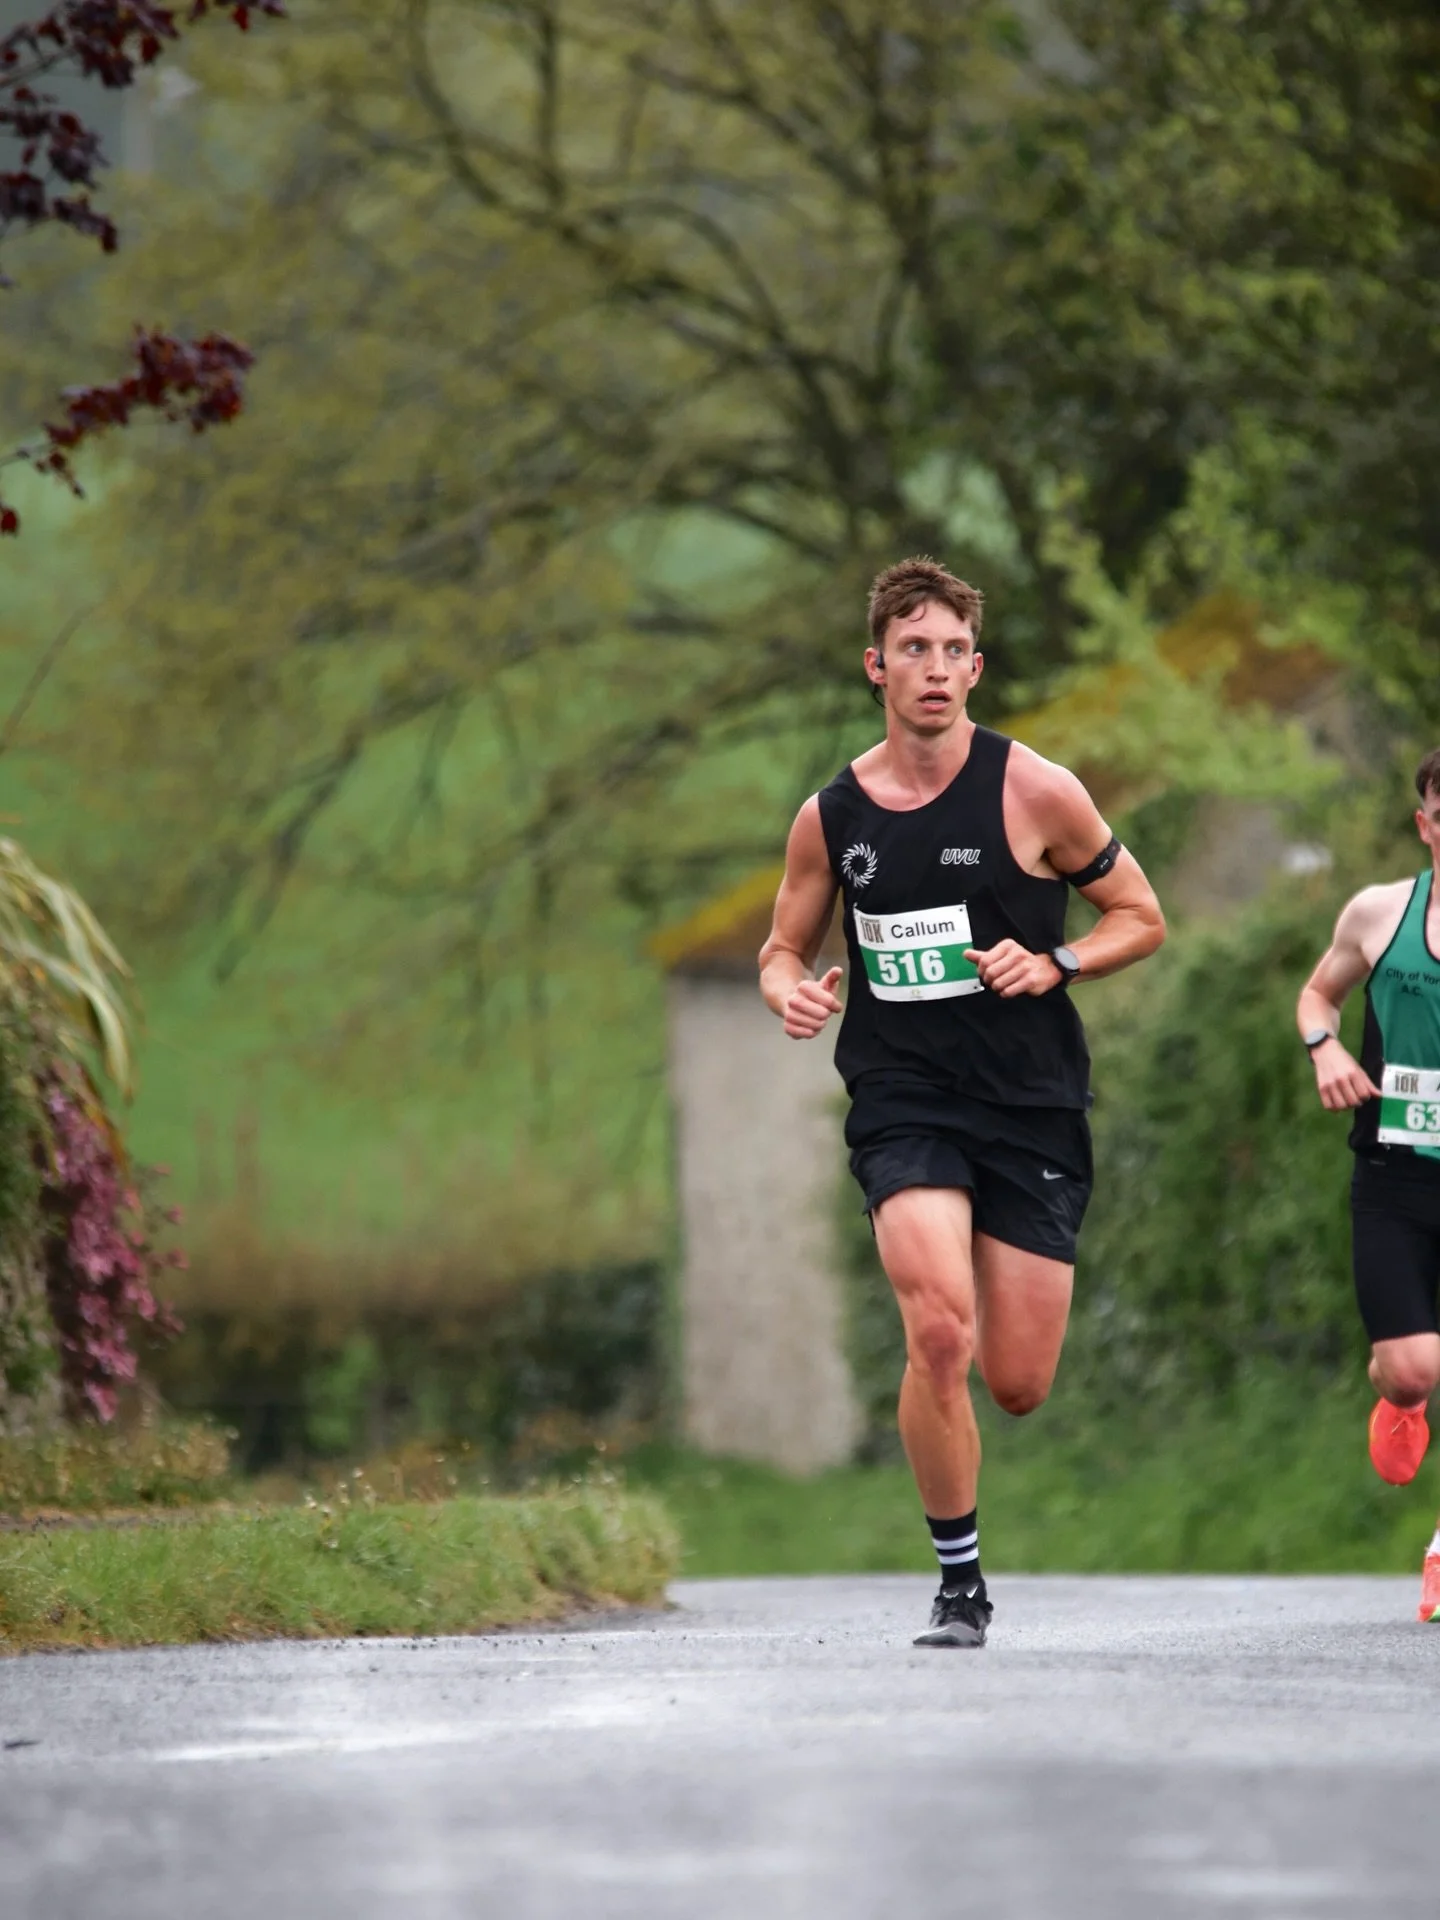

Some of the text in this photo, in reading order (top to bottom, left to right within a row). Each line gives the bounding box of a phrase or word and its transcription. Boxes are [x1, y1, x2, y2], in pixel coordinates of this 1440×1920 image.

[860, 919, 955, 943] 10K Callum
[878, 949, 945, 985] 516
[1386, 967, 1406, 981] City
[1408, 971, 1420, 981] of
[1395, 1074, 1419, 1094] 10K
[1406, 1102, 1440, 1132] 63
